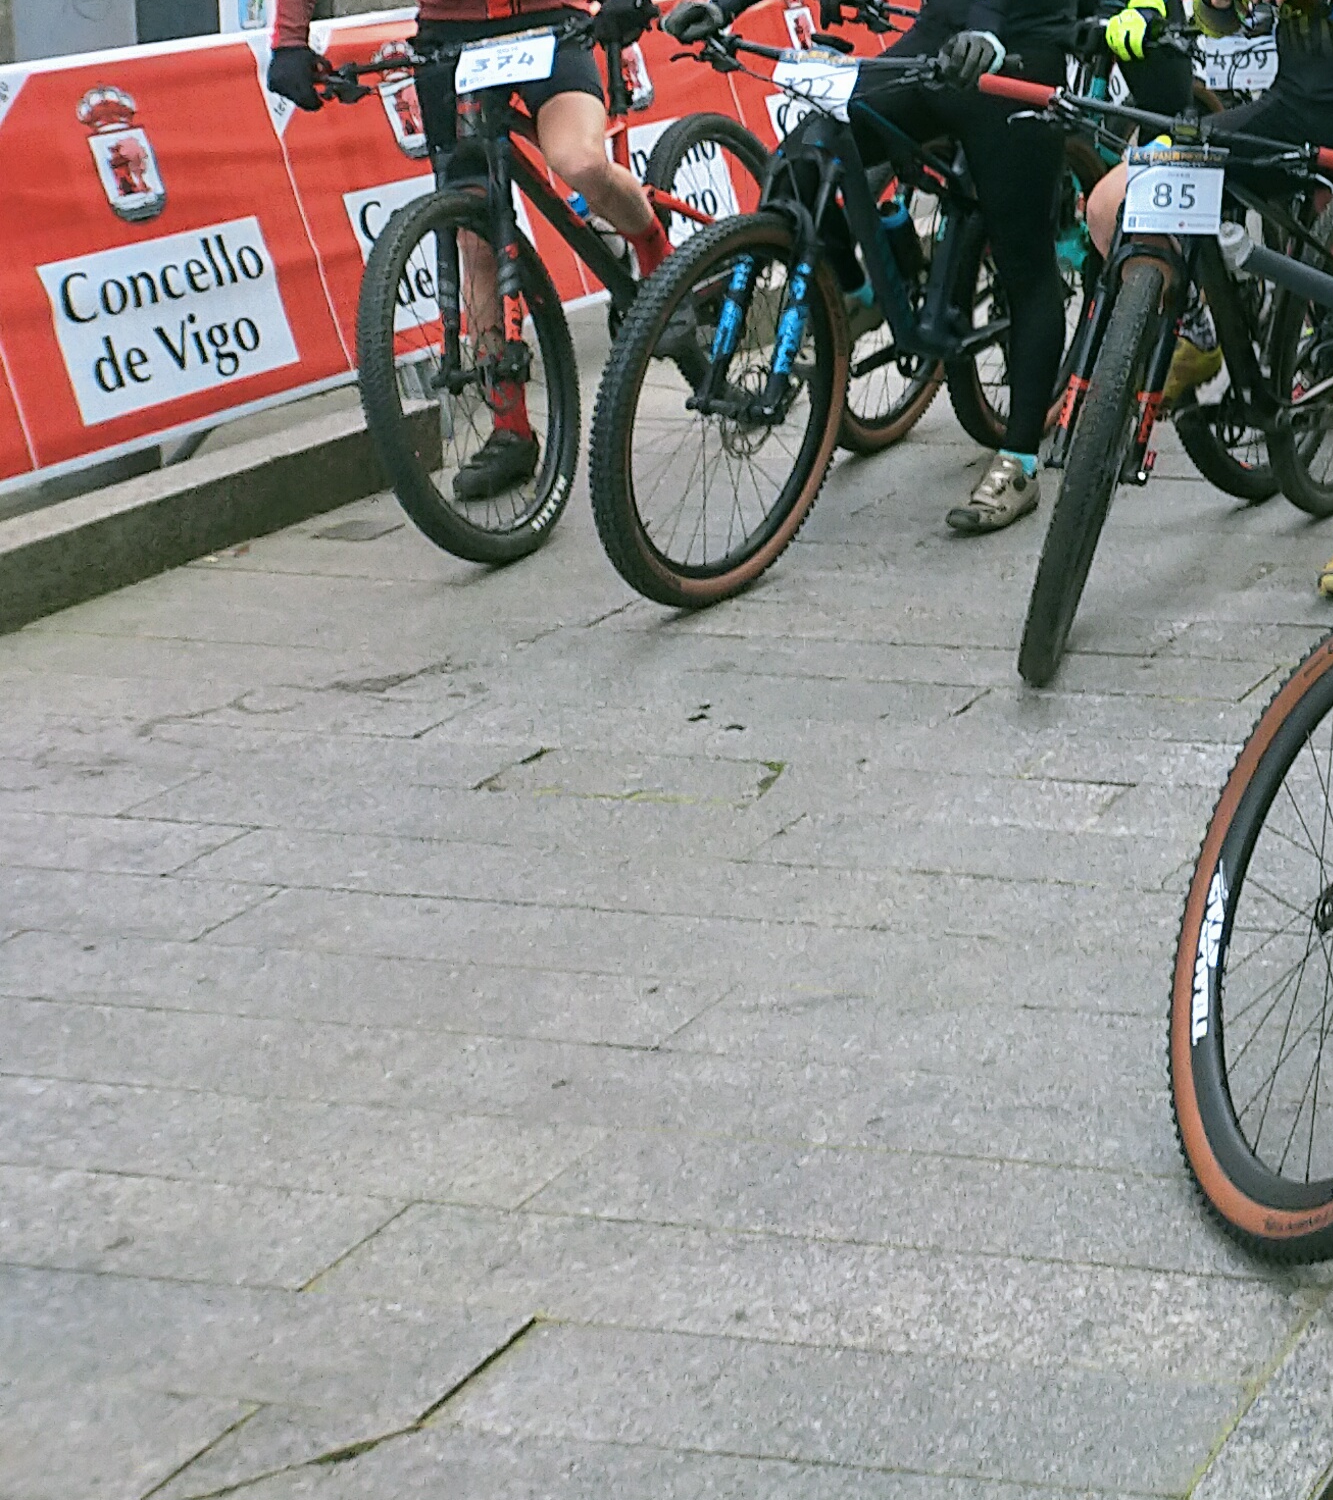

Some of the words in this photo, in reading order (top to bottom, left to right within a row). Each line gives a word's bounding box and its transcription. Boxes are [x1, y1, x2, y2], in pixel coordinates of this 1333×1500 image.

[1152, 182, 1196, 210] 85
[60, 234, 265, 324] Concello
[95, 334, 152, 393] de
[153, 312, 261, 377] Vigo
